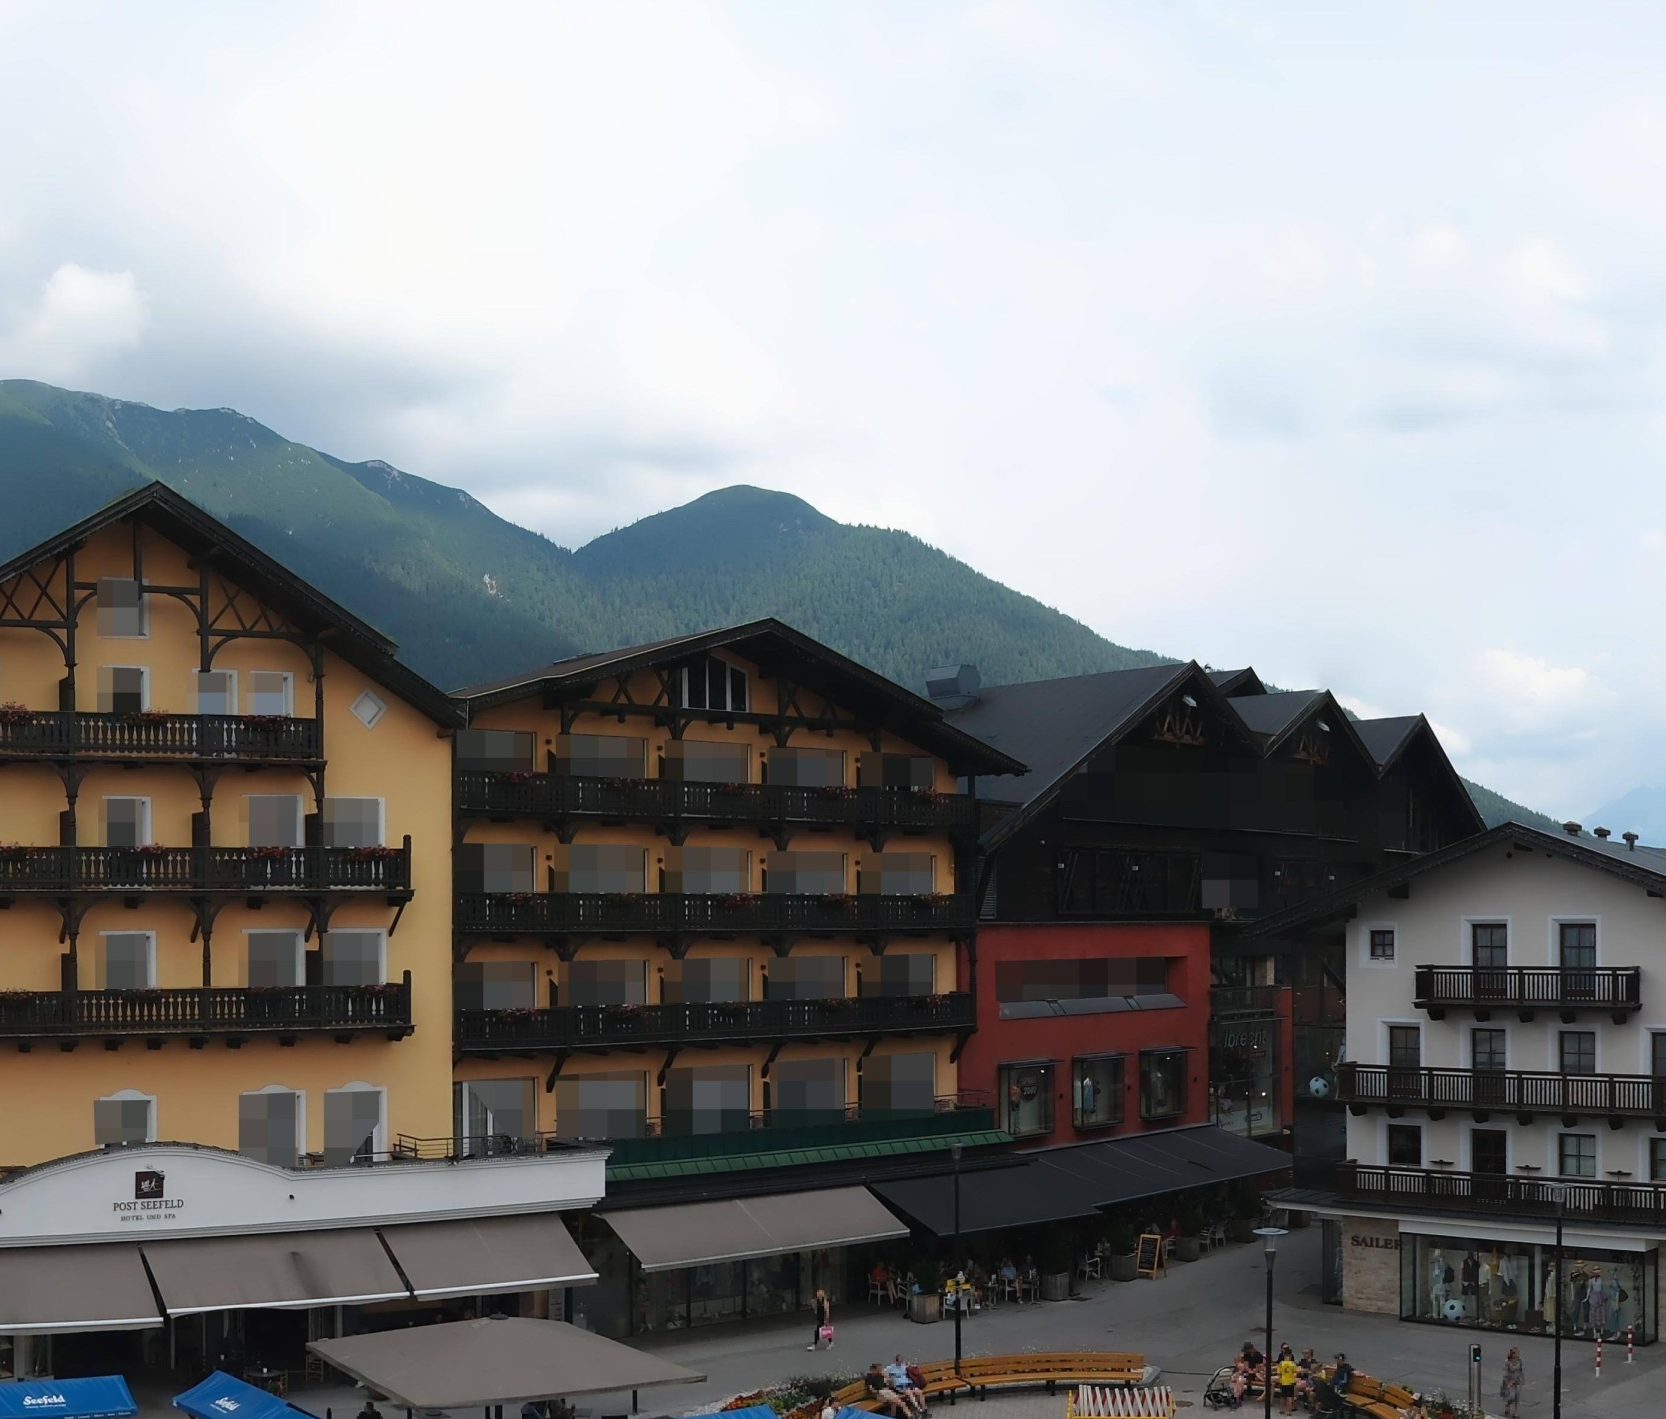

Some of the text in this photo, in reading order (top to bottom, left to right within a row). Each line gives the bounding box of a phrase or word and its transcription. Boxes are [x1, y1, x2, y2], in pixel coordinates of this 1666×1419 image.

[113, 1199, 185, 1212] POST SEEFELD
[120, 1214, 144, 1222] HOTEL
[23, 1394, 66, 1406] Seefeld
